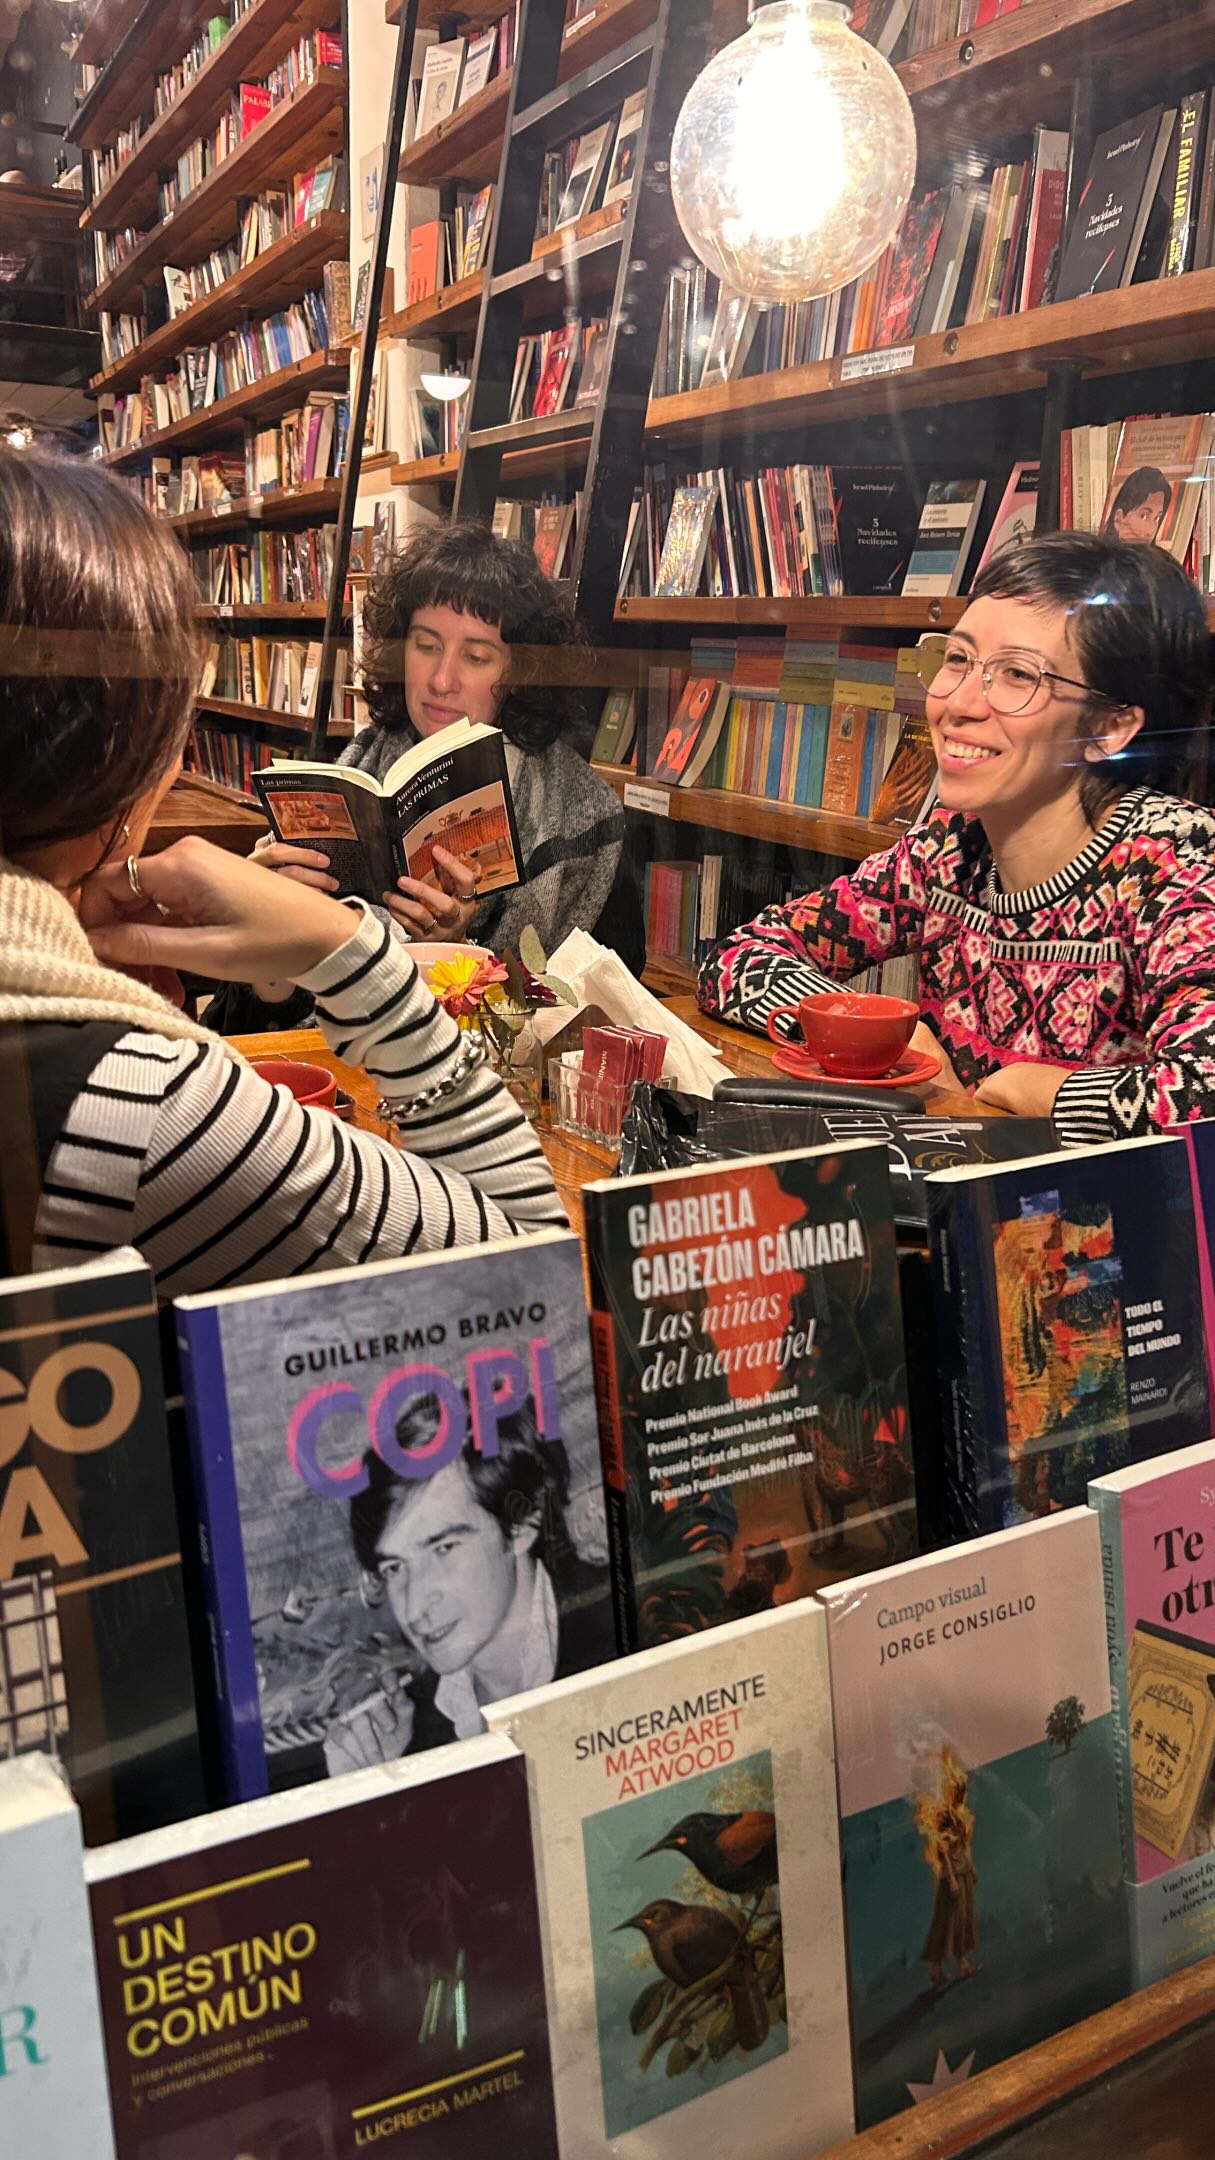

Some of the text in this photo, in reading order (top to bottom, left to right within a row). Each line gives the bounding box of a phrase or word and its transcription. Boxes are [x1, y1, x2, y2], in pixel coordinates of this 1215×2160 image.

[1182, 110, 1196, 134] EL
[1106, 192, 1114, 207] 3
[1173, 137, 1194, 219] FAMILIAR
[1089, 204, 1123, 226] Navidades
[857, 527, 898, 537] Navidades
[872, 517, 880, 528] 3
[396, 757, 454, 806] Aurora Venturini
[397, 773, 449, 819] LAS PRIMAS
[628, 1187, 756, 1249] GABRIELA
[632, 1218, 865, 1301] CABEZÓN CÁMARA
[637, 1290, 783, 1349] Las niñas
[1125, 1302, 1151, 1319] TODO
[1126, 1319, 1163, 1338] TIEMPO
[284, 1302, 547, 1377] GUILLERMO BRAVO
[641, 1318, 817, 1394] del naranjel
[1127, 1333, 1182, 1357] DEL MUNDO
[0, 1341, 142, 1469] O
[645, 1384, 799, 1434] Premio National Book Award
[1130, 1378, 1155, 1391] RENZO
[1131, 1387, 1168, 1405] MAINARDI
[285, 1335, 562, 1501] COPI
[647, 1405, 820, 1457] Premio Sor Juana Inés de la Cruz
[649, 1432, 797, 1481] Premio Ciutat de Barcelona
[651, 1484, 692, 1504] Premio
[692, 1467, 749, 1493] Fundación
[788, 1451, 814, 1468] Filba
[1154, 1526, 1205, 1573] Te
[876, 1575, 988, 1630] Campo visual
[879, 1594, 1037, 1666] JORGE CONSIGLIO
[574, 1673, 767, 1761] SINCERAMENTE
[605, 1706, 744, 1777] MARGARET
[618, 1739, 735, 1800] ATWOOD
[117, 1916, 186, 1969] UN
[122, 1921, 317, 2016] DESTINO
[126, 1968, 302, 2057] COMÚN
[131, 2039, 243, 2086] Intervenciones
[147, 2051, 266, 2101] conversaciones
[354, 2069, 525, 2146] LUCRECIA MARTEL
